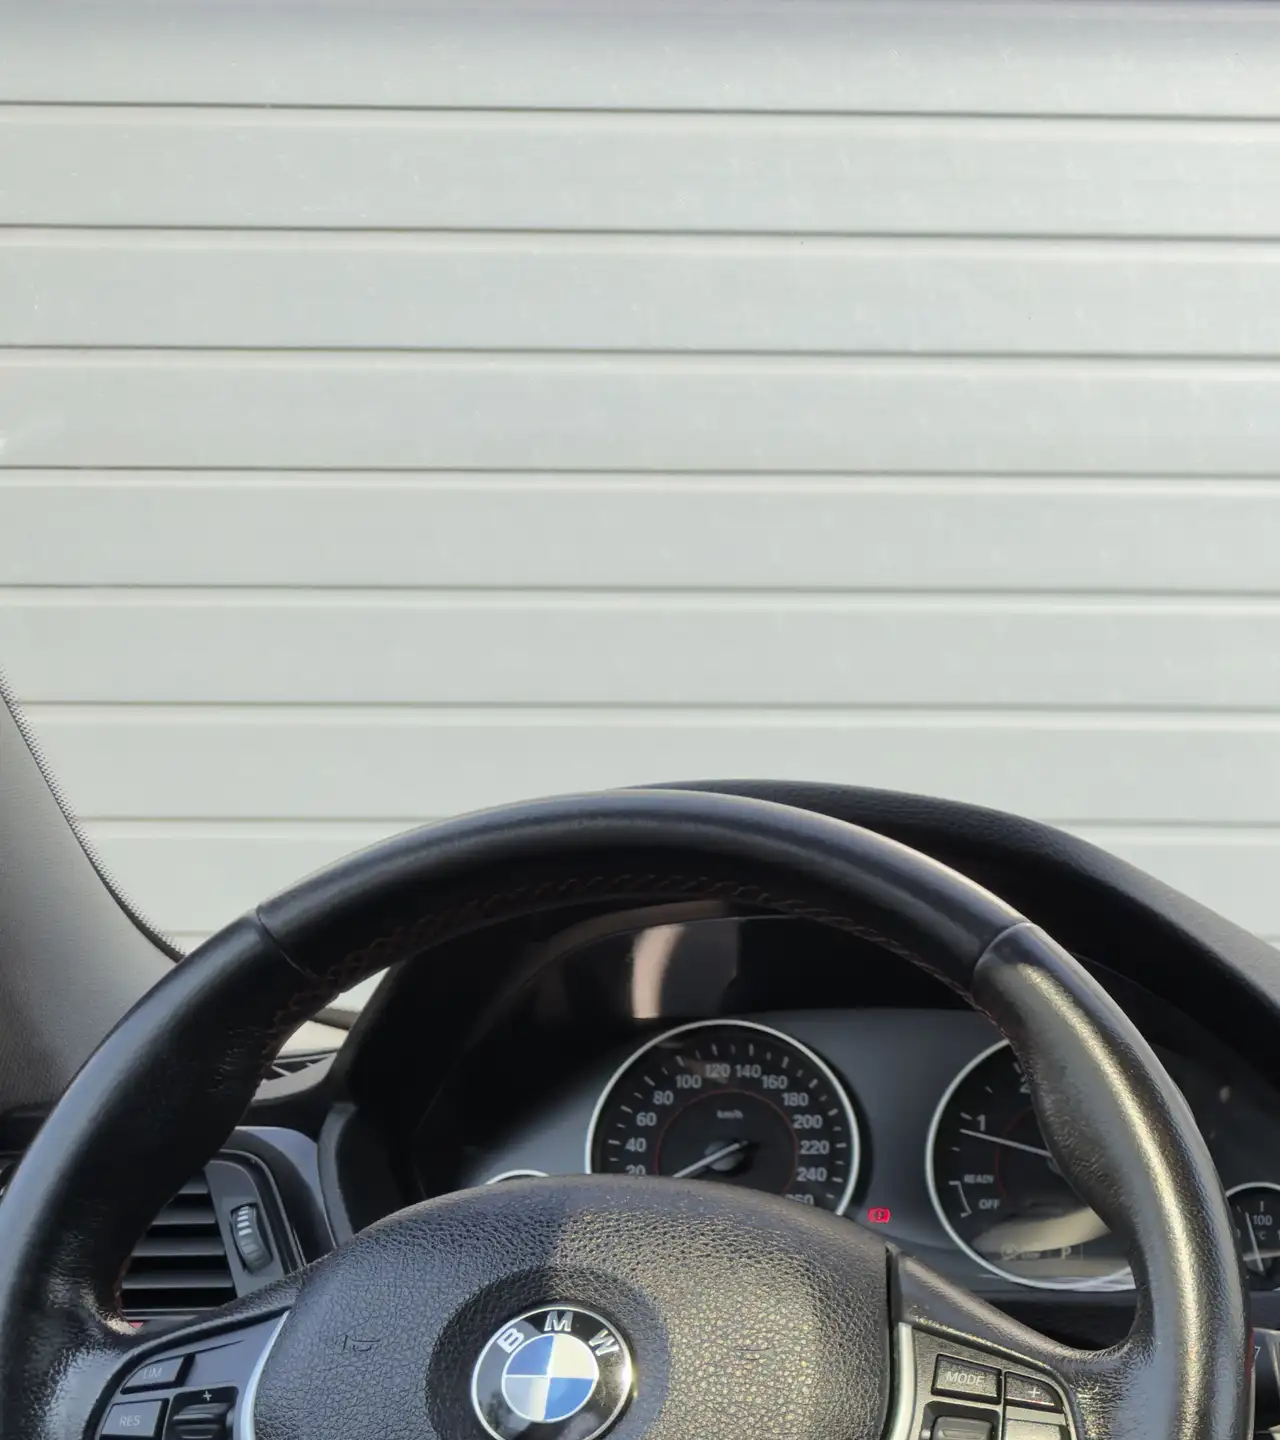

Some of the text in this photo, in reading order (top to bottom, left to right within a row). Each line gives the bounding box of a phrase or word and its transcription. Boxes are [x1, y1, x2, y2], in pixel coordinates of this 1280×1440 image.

[705, 1063, 731, 1078] 120
[736, 1064, 762, 1078] 140
[676, 1074, 702, 1089] 100
[761, 1075, 788, 1089] 160
[652, 1090, 674, 1105] 80
[782, 1092, 809, 1107] 180
[636, 1112, 658, 1127] 60
[792, 1114, 823, 1129] 200
[976, 1114, 986, 1132] 1
[625, 1137, 647, 1153] 40
[800, 1140, 830, 1155] 220
[796, 1167, 828, 1182] 240
[964, 1174, 994, 1185] READY
[979, 1199, 1000, 1210] OFF
[1252, 1214, 1273, 1226] 100
[496, 1310, 621, 1357] BMW
[143, 1367, 163, 1380] LIM
[946, 1371, 985, 1386] MODE
[119, 1415, 141, 1428] RES
